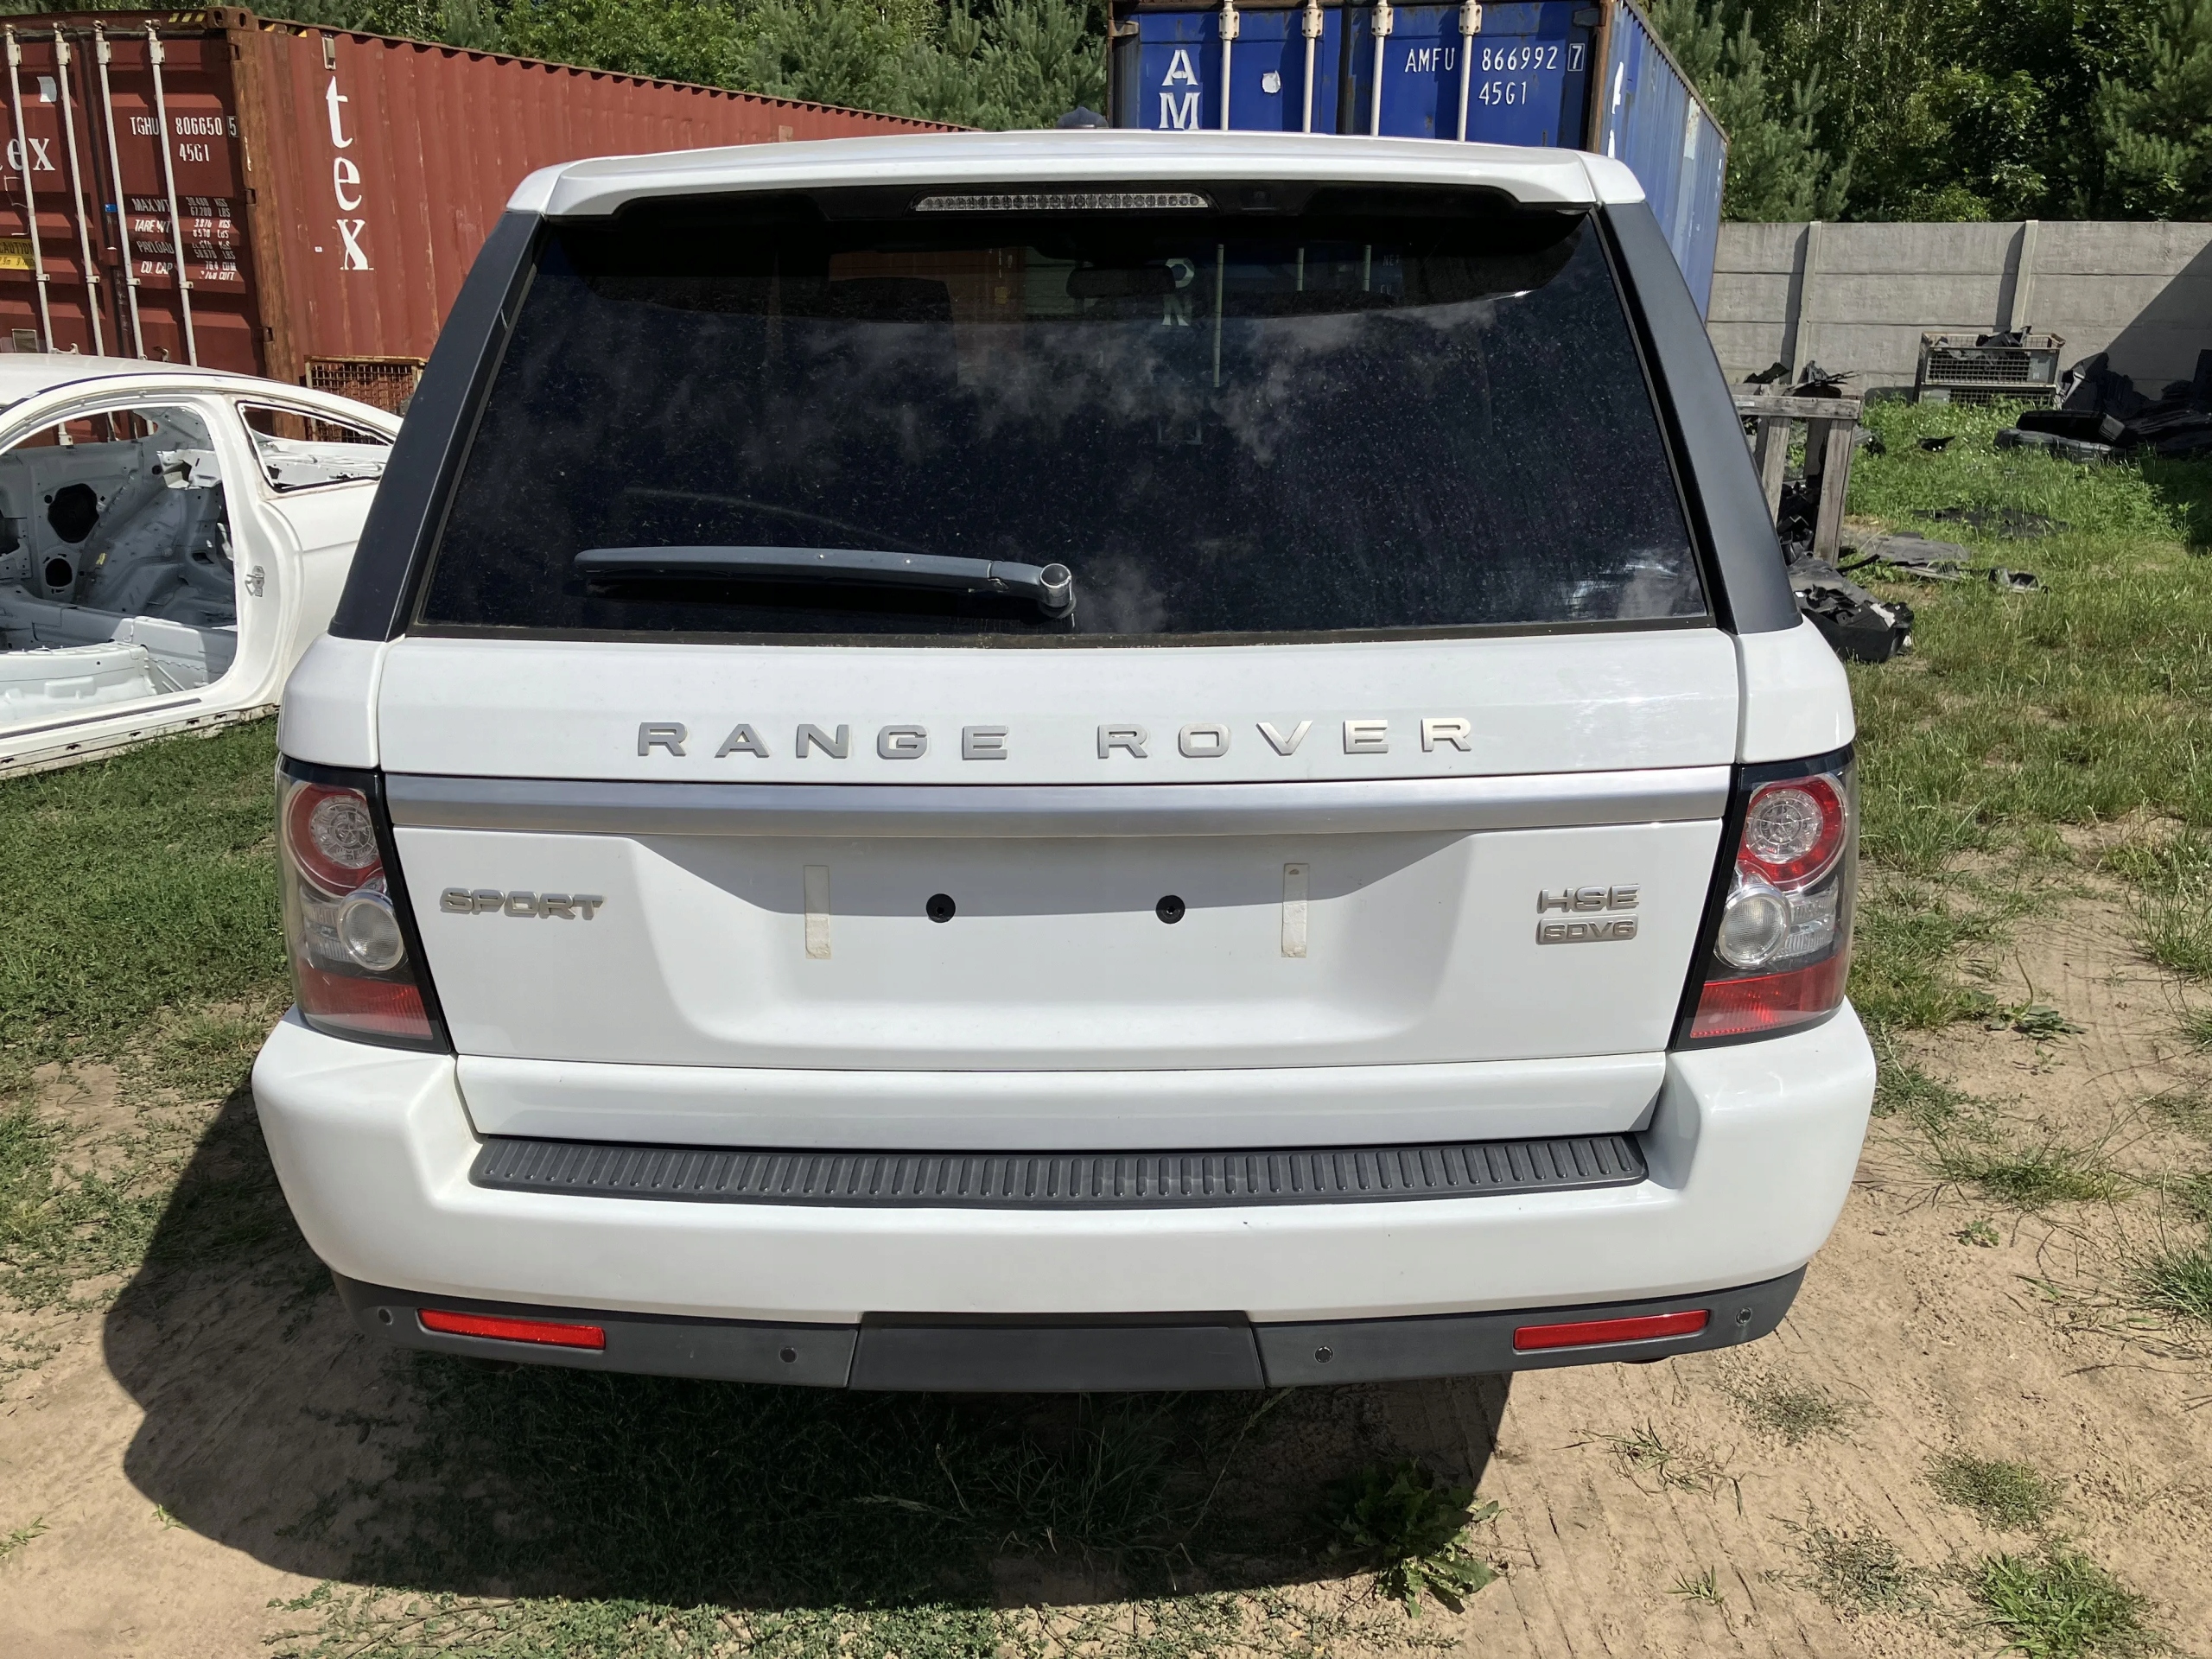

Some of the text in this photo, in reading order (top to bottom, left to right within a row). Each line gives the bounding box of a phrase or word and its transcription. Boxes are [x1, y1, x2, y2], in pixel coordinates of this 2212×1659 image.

[1404, 45, 1583, 73] AMFU 866992 7
[1478, 81, 1527, 105] 45G1
[130, 116, 237, 137] TGHU 806650 5
[0, 137, 56, 172] ex
[218, 207, 231, 218] LBS
[134, 219, 155, 233] TARE
[637, 716, 1472, 761] RANGE ROVER
[439, 887, 604, 921] SPORT
[1536, 883, 1641, 914] HSE
[1541, 918, 1637, 942] SDV6
